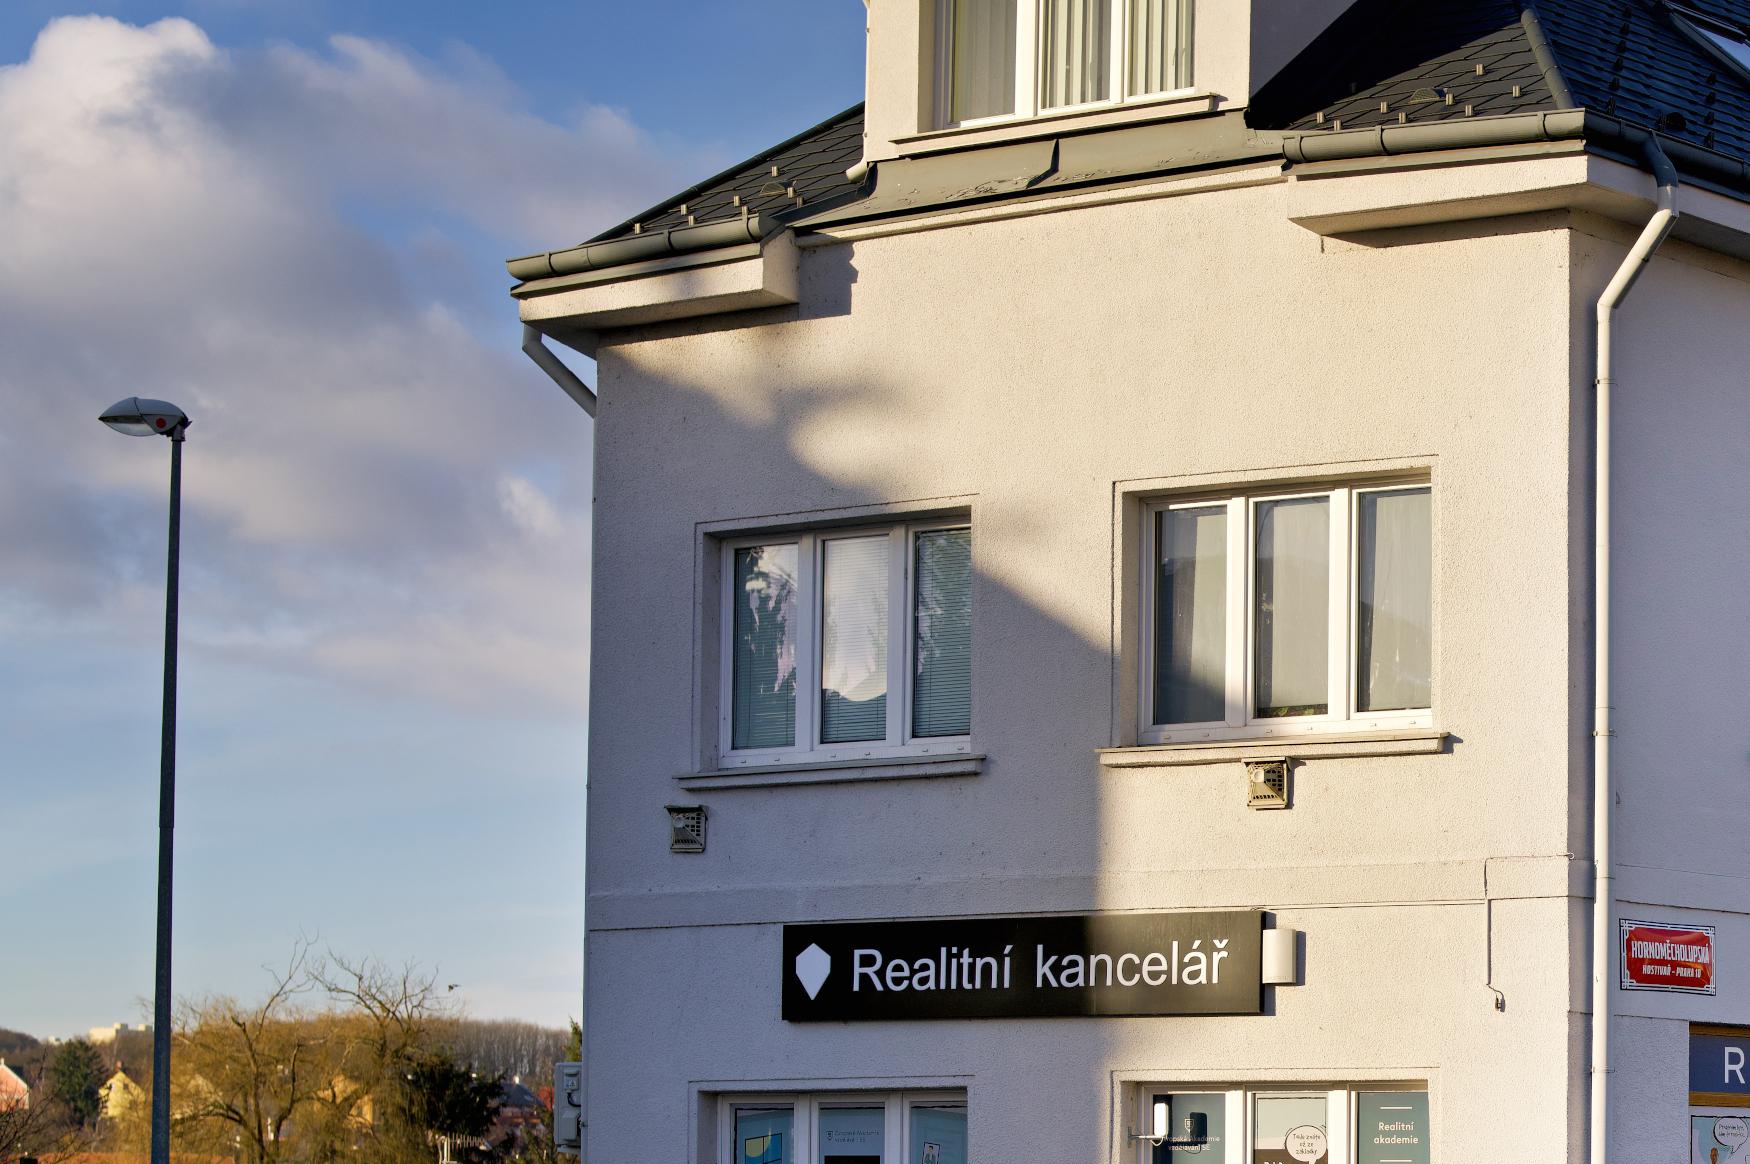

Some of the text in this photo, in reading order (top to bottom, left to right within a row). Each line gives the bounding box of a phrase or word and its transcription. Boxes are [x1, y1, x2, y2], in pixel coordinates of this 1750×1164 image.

[1631, 940, 1710, 964] HORNOMĚCHOLUPSKÁ
[852, 939, 1230, 992] Realitní kancelář
[1642, 964, 1671, 976] HOSTIVAŘ
[1676, 966, 1694, 978] PRAHA
[1695, 968, 1702, 978] 10
[1378, 1122, 1414, 1132] Realitní
[1373, 1134, 1419, 1144] akademie
